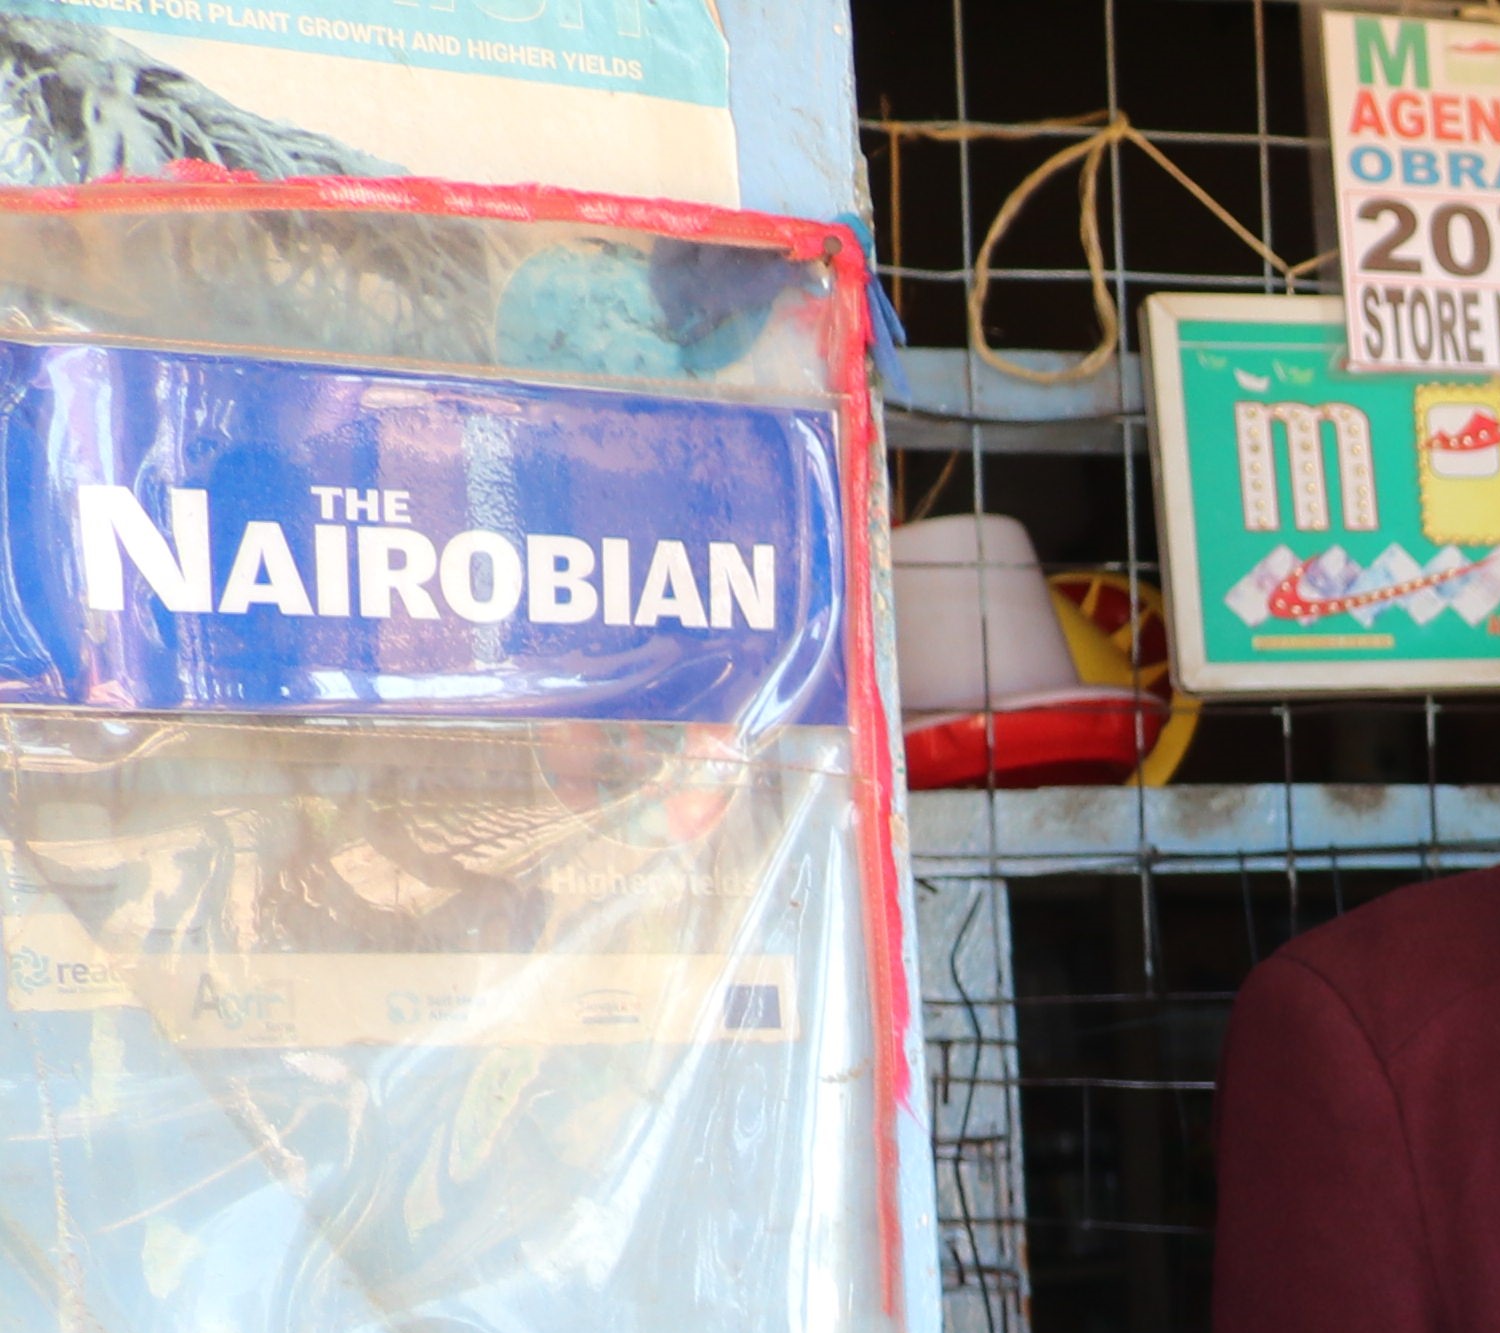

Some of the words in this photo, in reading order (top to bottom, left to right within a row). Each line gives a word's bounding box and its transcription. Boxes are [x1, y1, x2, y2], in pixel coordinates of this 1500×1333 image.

[150, 0, 202, 21] FOR
[208, 4, 290, 33] PLANT
[298, 16, 407, 49] GROWTH
[412, 28, 461, 56] AND
[467, 37, 557, 70] HIGHER
[562, 52, 645, 81] YIELDS
[1361, 283, 1485, 364] STORE
[311, 484, 412, 524] THE
[76, 484, 776, 631] NAIROBIAN
